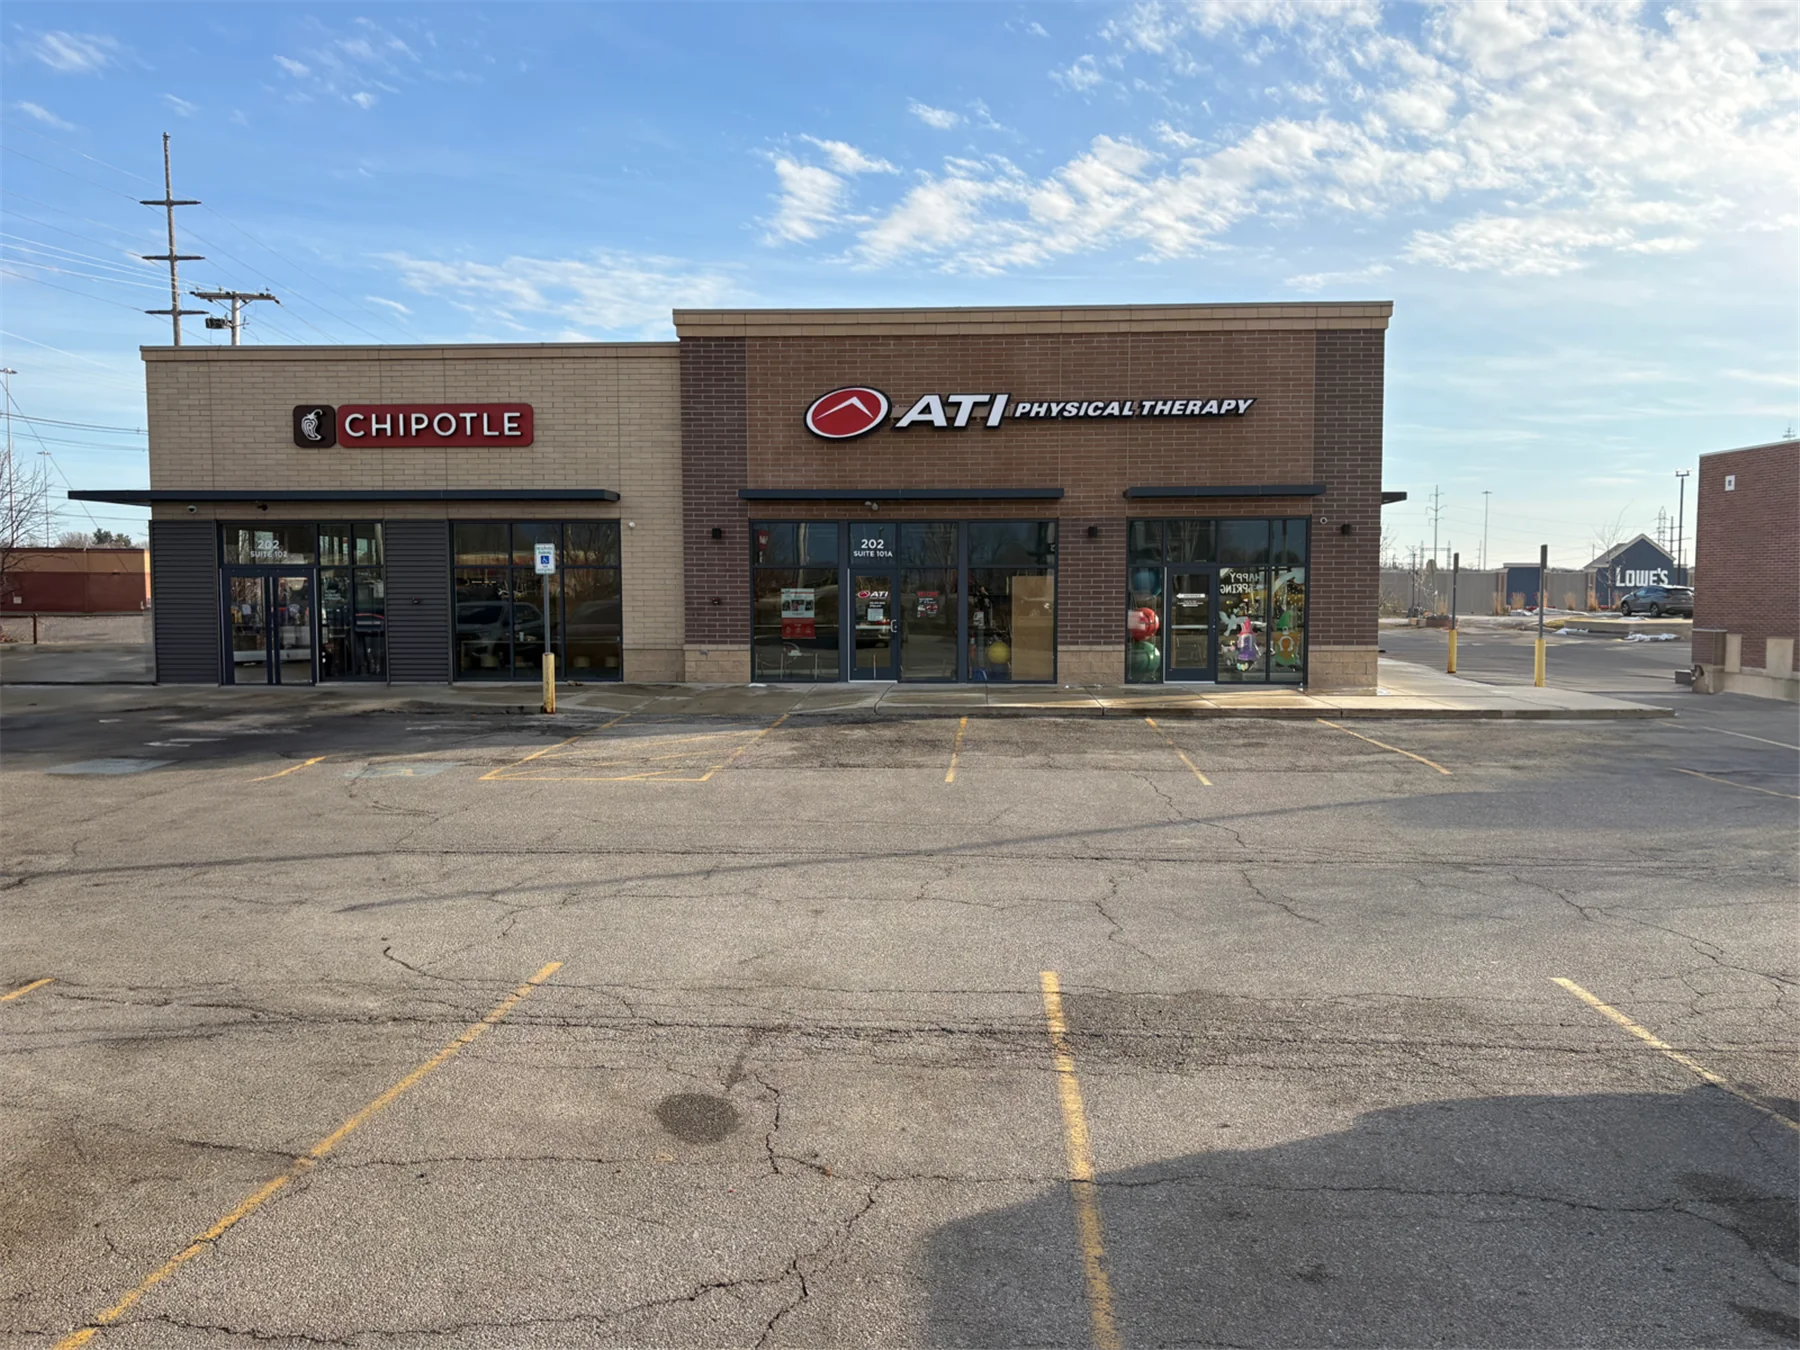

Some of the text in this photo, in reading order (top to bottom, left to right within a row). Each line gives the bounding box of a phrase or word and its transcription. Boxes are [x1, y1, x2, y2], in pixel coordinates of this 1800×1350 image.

[895, 393, 1256, 429] ATI PHYSICAL THERAPY
[344, 412, 523, 438] CHIPOTLE
[257, 540, 280, 549] 202
[861, 539, 884, 549] 202
[250, 550, 288, 558] SUITE 102
[853, 550, 893, 558] SUITE 101A
[1616, 567, 1669, 587] LOWE'S
